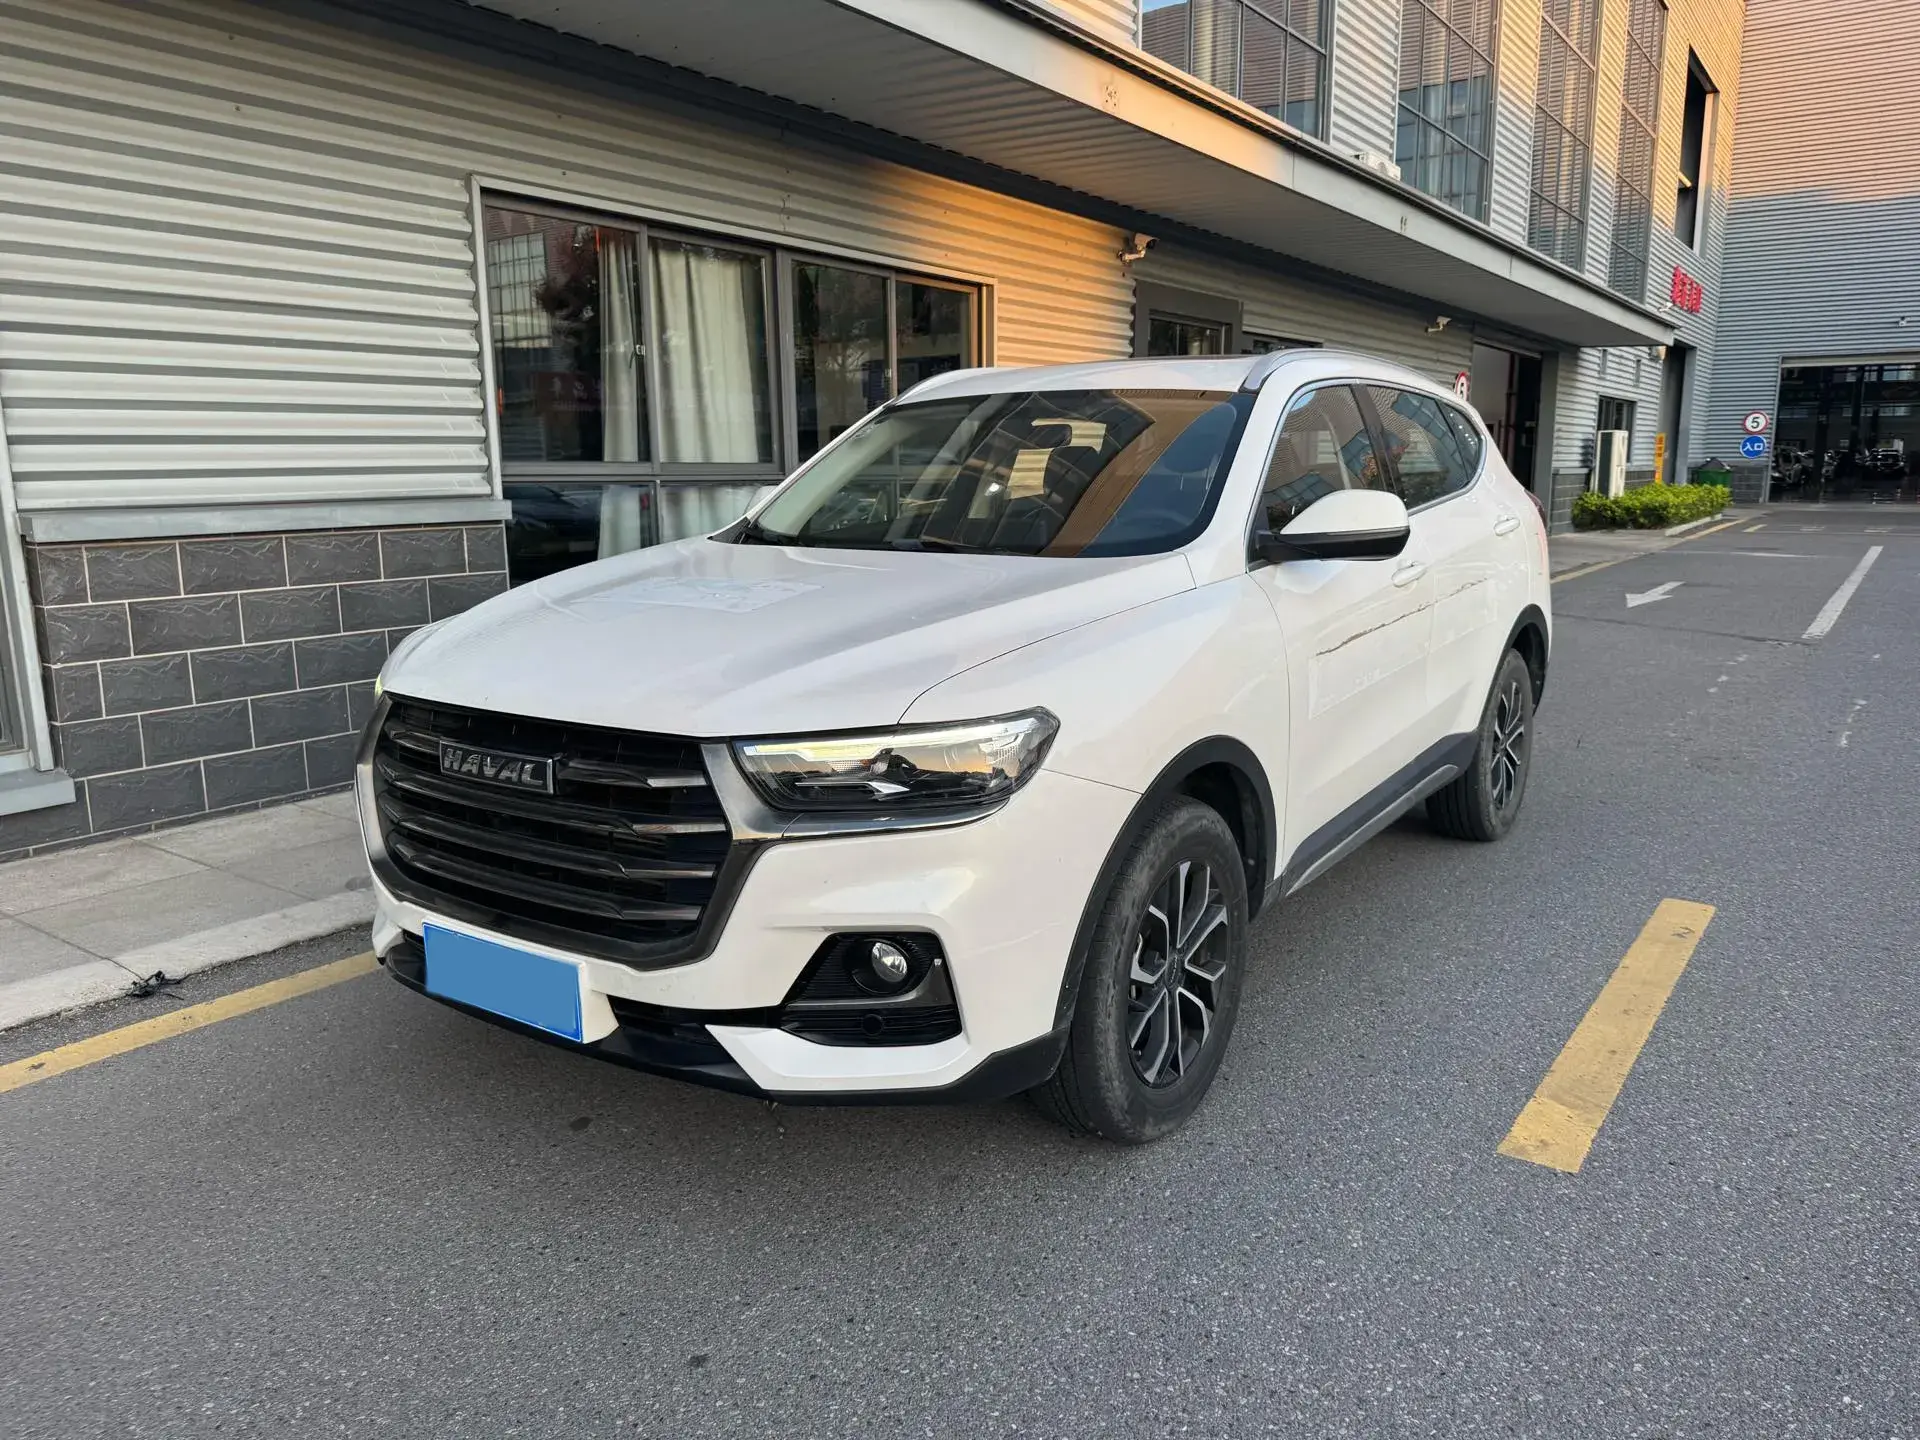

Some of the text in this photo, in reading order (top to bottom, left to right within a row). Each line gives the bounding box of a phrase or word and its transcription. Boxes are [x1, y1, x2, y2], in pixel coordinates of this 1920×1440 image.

[1751, 417, 1760, 429] 5
[1743, 442, 1763, 452] 入口
[443, 748, 544, 786] HAVAL
